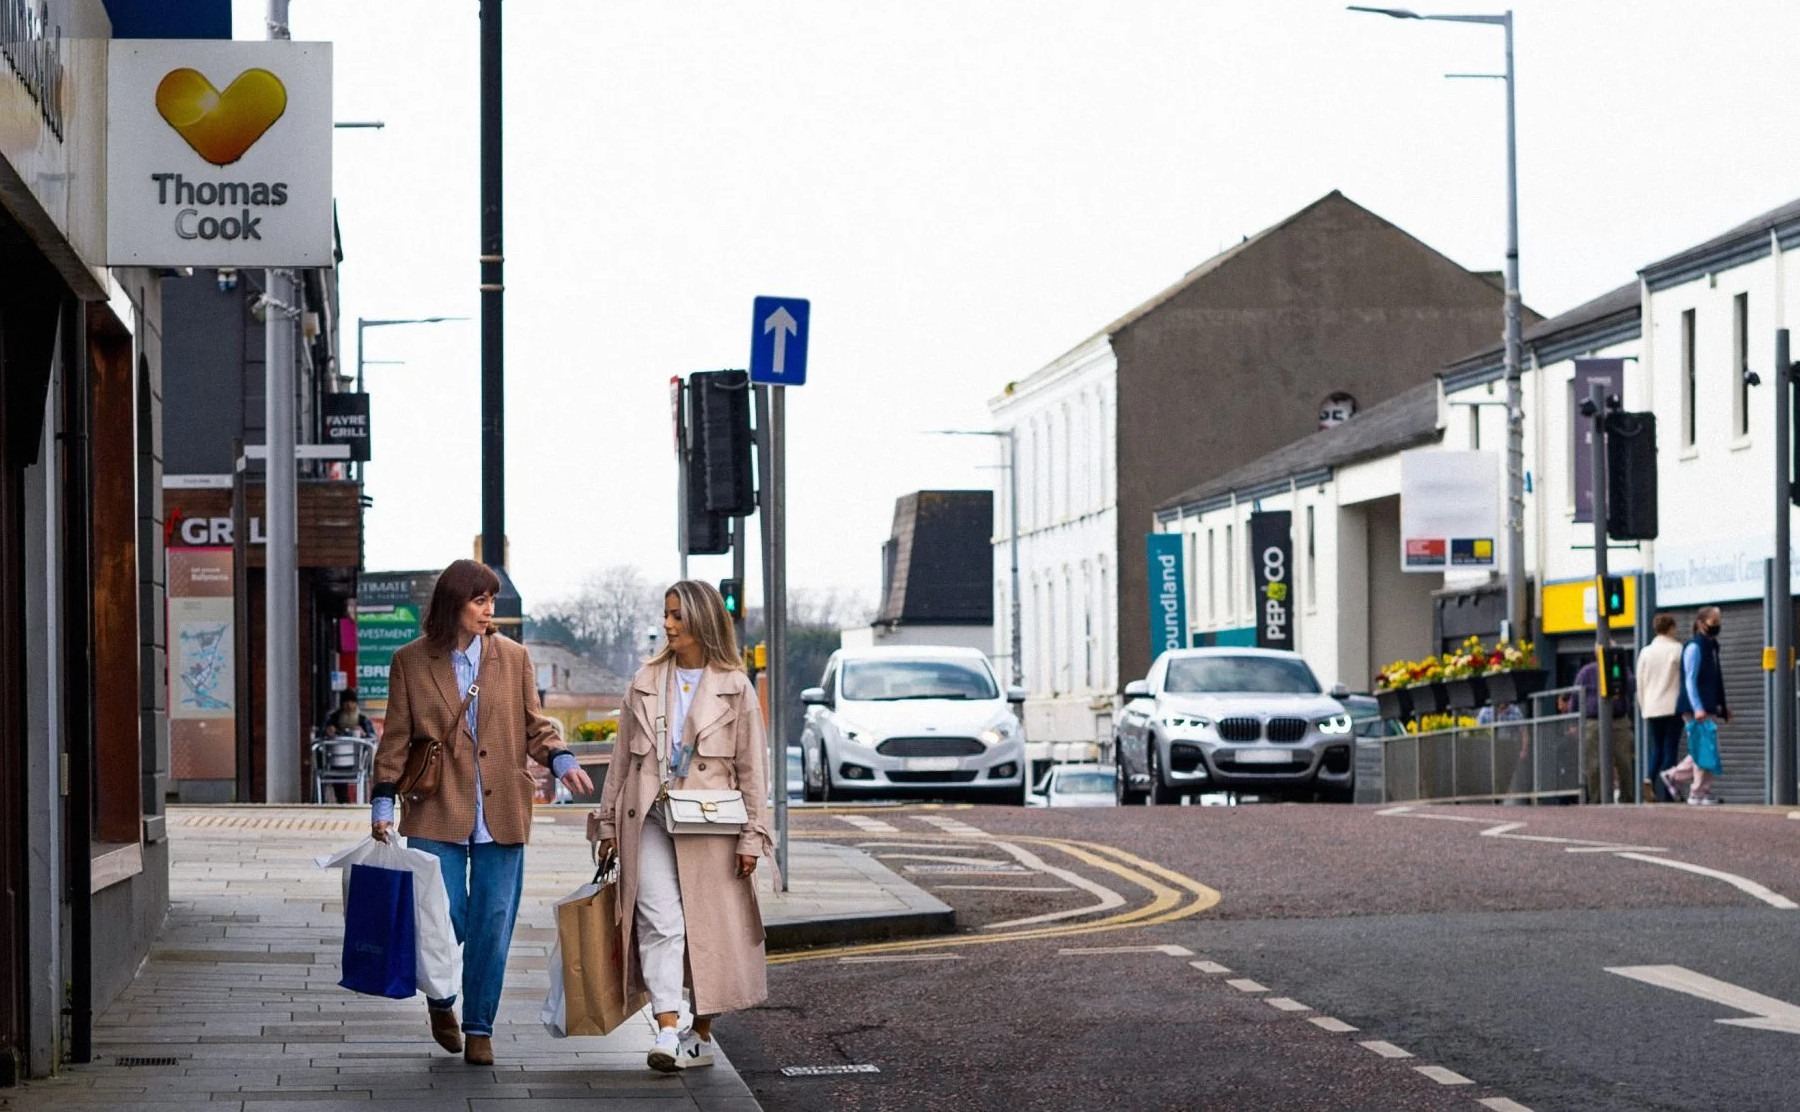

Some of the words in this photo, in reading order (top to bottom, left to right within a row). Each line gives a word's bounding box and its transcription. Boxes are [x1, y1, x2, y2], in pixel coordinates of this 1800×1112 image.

[151, 173, 288, 206] Thomas
[175, 208, 262, 240] Cook
[326, 415, 366, 425] FAVRE
[329, 427, 368, 437] GRILL
[181, 516, 268, 545] GRL
[357, 581, 409, 592] TIMATE
[1158, 554, 1180, 650] oundland
[357, 629, 415, 639] NVESTMENT
